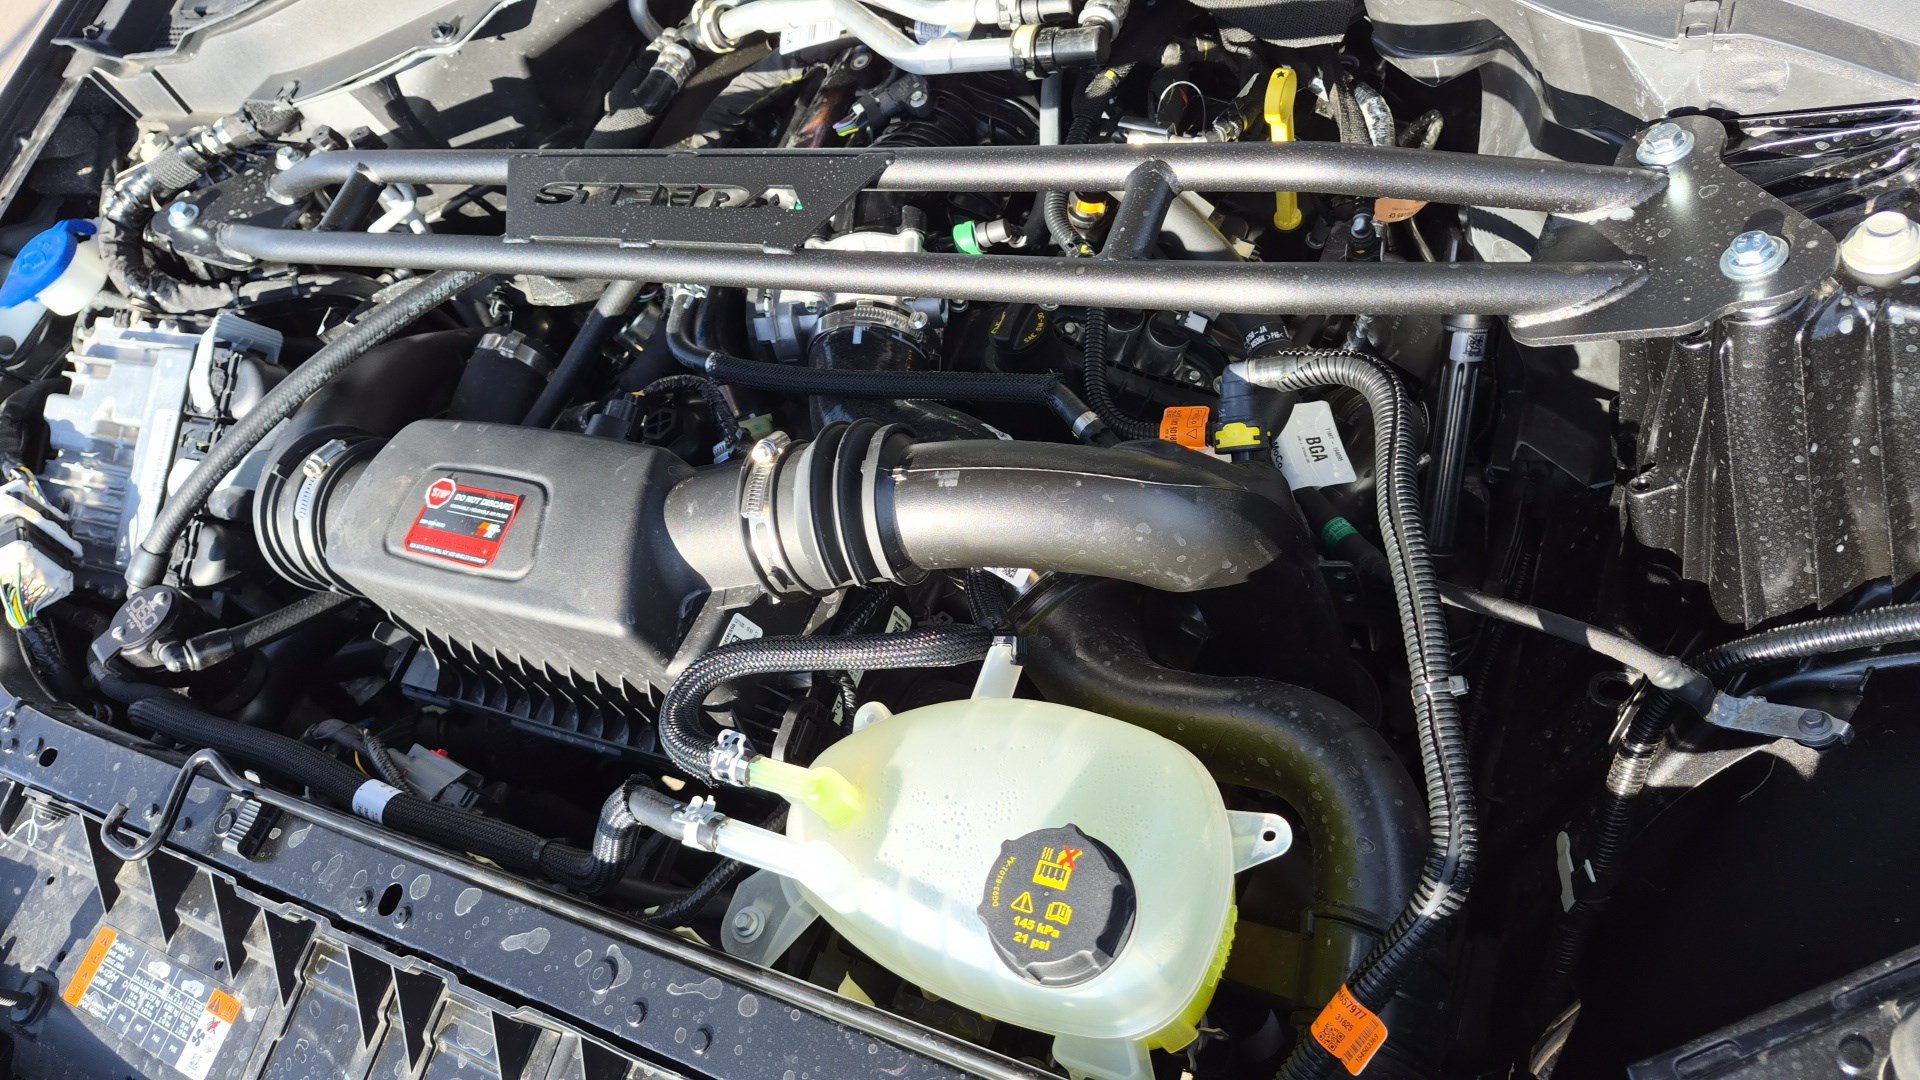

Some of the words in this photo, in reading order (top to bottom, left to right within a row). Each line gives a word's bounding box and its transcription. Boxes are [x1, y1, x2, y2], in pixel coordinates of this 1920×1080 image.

[1305, 436, 1328, 463] BGA
[431, 487, 452, 499] STOP
[453, 493, 464, 502] DO
[465, 495, 482, 505] NOT
[480, 499, 515, 511] DISCARD
[1013, 915, 1035, 931] 145
[1036, 922, 1060, 939] kPa
[1013, 931, 1029, 944] 21
[1030, 937, 1050, 950] psi
